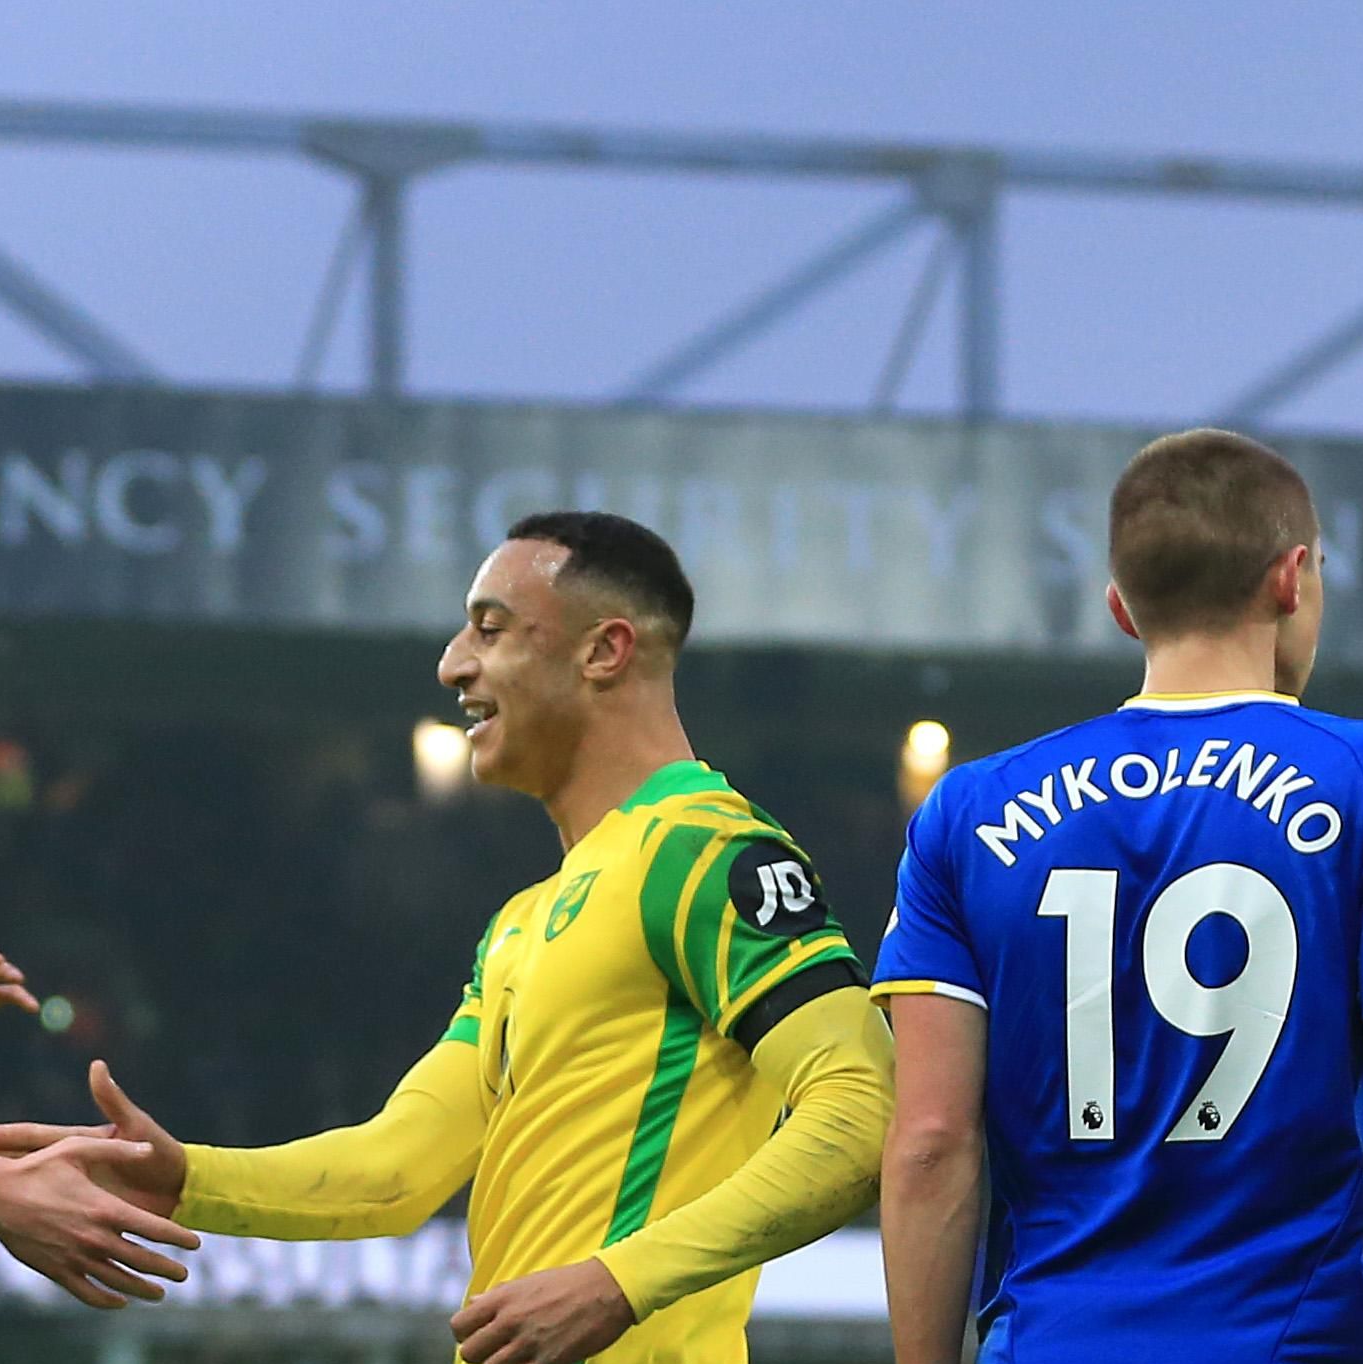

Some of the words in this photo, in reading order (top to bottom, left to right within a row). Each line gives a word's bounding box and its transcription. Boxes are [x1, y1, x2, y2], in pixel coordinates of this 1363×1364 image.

[974, 739, 1343, 867] MYKOLENKO
[755, 860, 816, 927] JD
[1037, 862, 1299, 1142] 19
